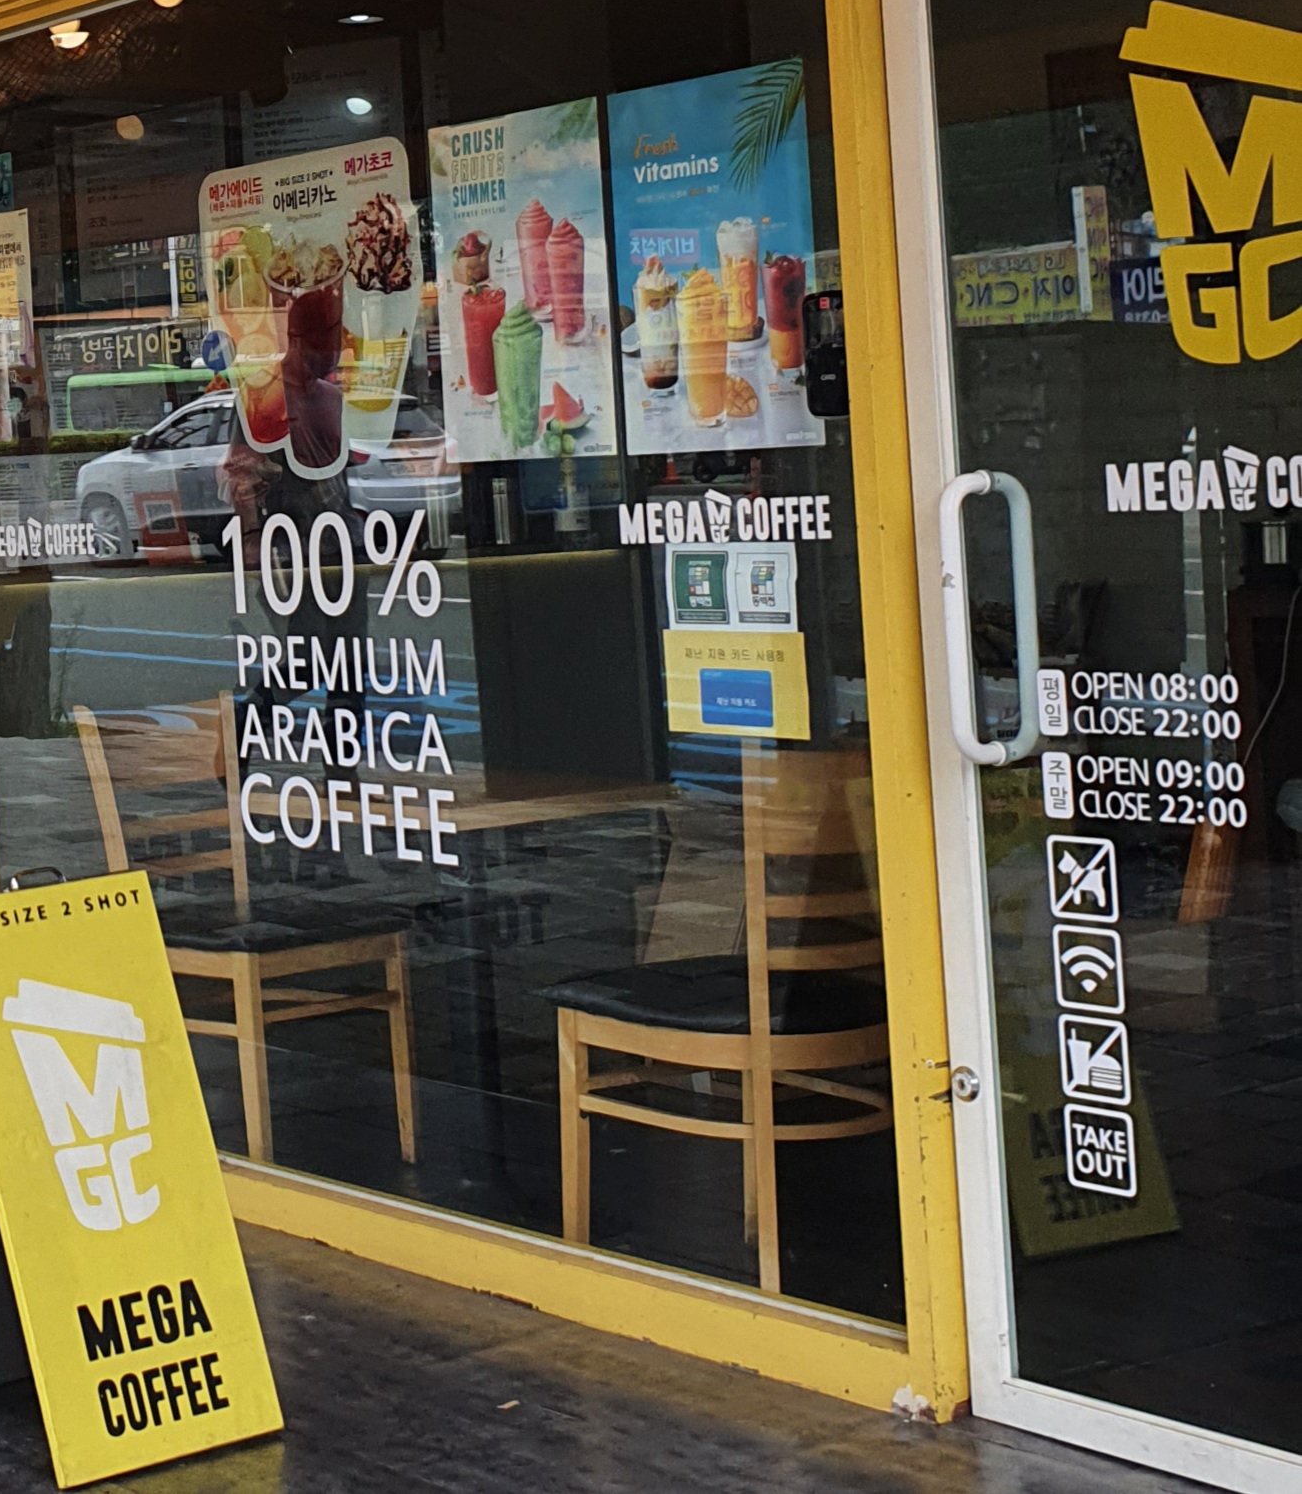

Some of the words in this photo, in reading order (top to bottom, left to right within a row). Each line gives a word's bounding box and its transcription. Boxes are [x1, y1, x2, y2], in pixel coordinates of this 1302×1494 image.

[451, 126, 505, 157] CRUSH
[344, 150, 395, 176] 메가초코
[451, 152, 505, 183] FRUITS
[208, 176, 264, 201] 메가에이드
[272, 184, 338, 213] 아메리카노
[452, 179, 506, 208] SUMMER
[1105, 459, 1226, 513] MEGA
[44, 522, 96, 556] COFFEE
[618, 501, 703, 545] MEGA
[736, 494, 832, 542] COFFEE
[221, 508, 443, 619] 100%
[235, 634, 447, 697] PREMIUM
[1040, 675, 1064, 729] 평일
[1071, 670, 1144, 702] OPEN
[1149, 672, 1240, 705] 08:00
[239, 702, 454, 776] ARABICA
[1072, 706, 1146, 737] CLOSE
[1153, 708, 1243, 741] 22:00
[1046, 757, 1068, 810] 주말
[1076, 754, 1150, 788] OPEN
[1155, 758, 1246, 793] 09:00
[239, 771, 461, 868] COFFEE
[1079, 790, 1153, 822] CLOSE
[1157, 793, 1249, 829] 22:00
[0, 903, 49, 928] SIZE
[61, 899, 73, 917] 2
[84, 888, 143, 914] SHOT
[1071, 1120, 1128, 1157] TAKE
[1073, 1148, 1129, 1182] OUT
[76, 1277, 214, 1364] MEGA
[97, 1351, 231, 1440] COFFEE
